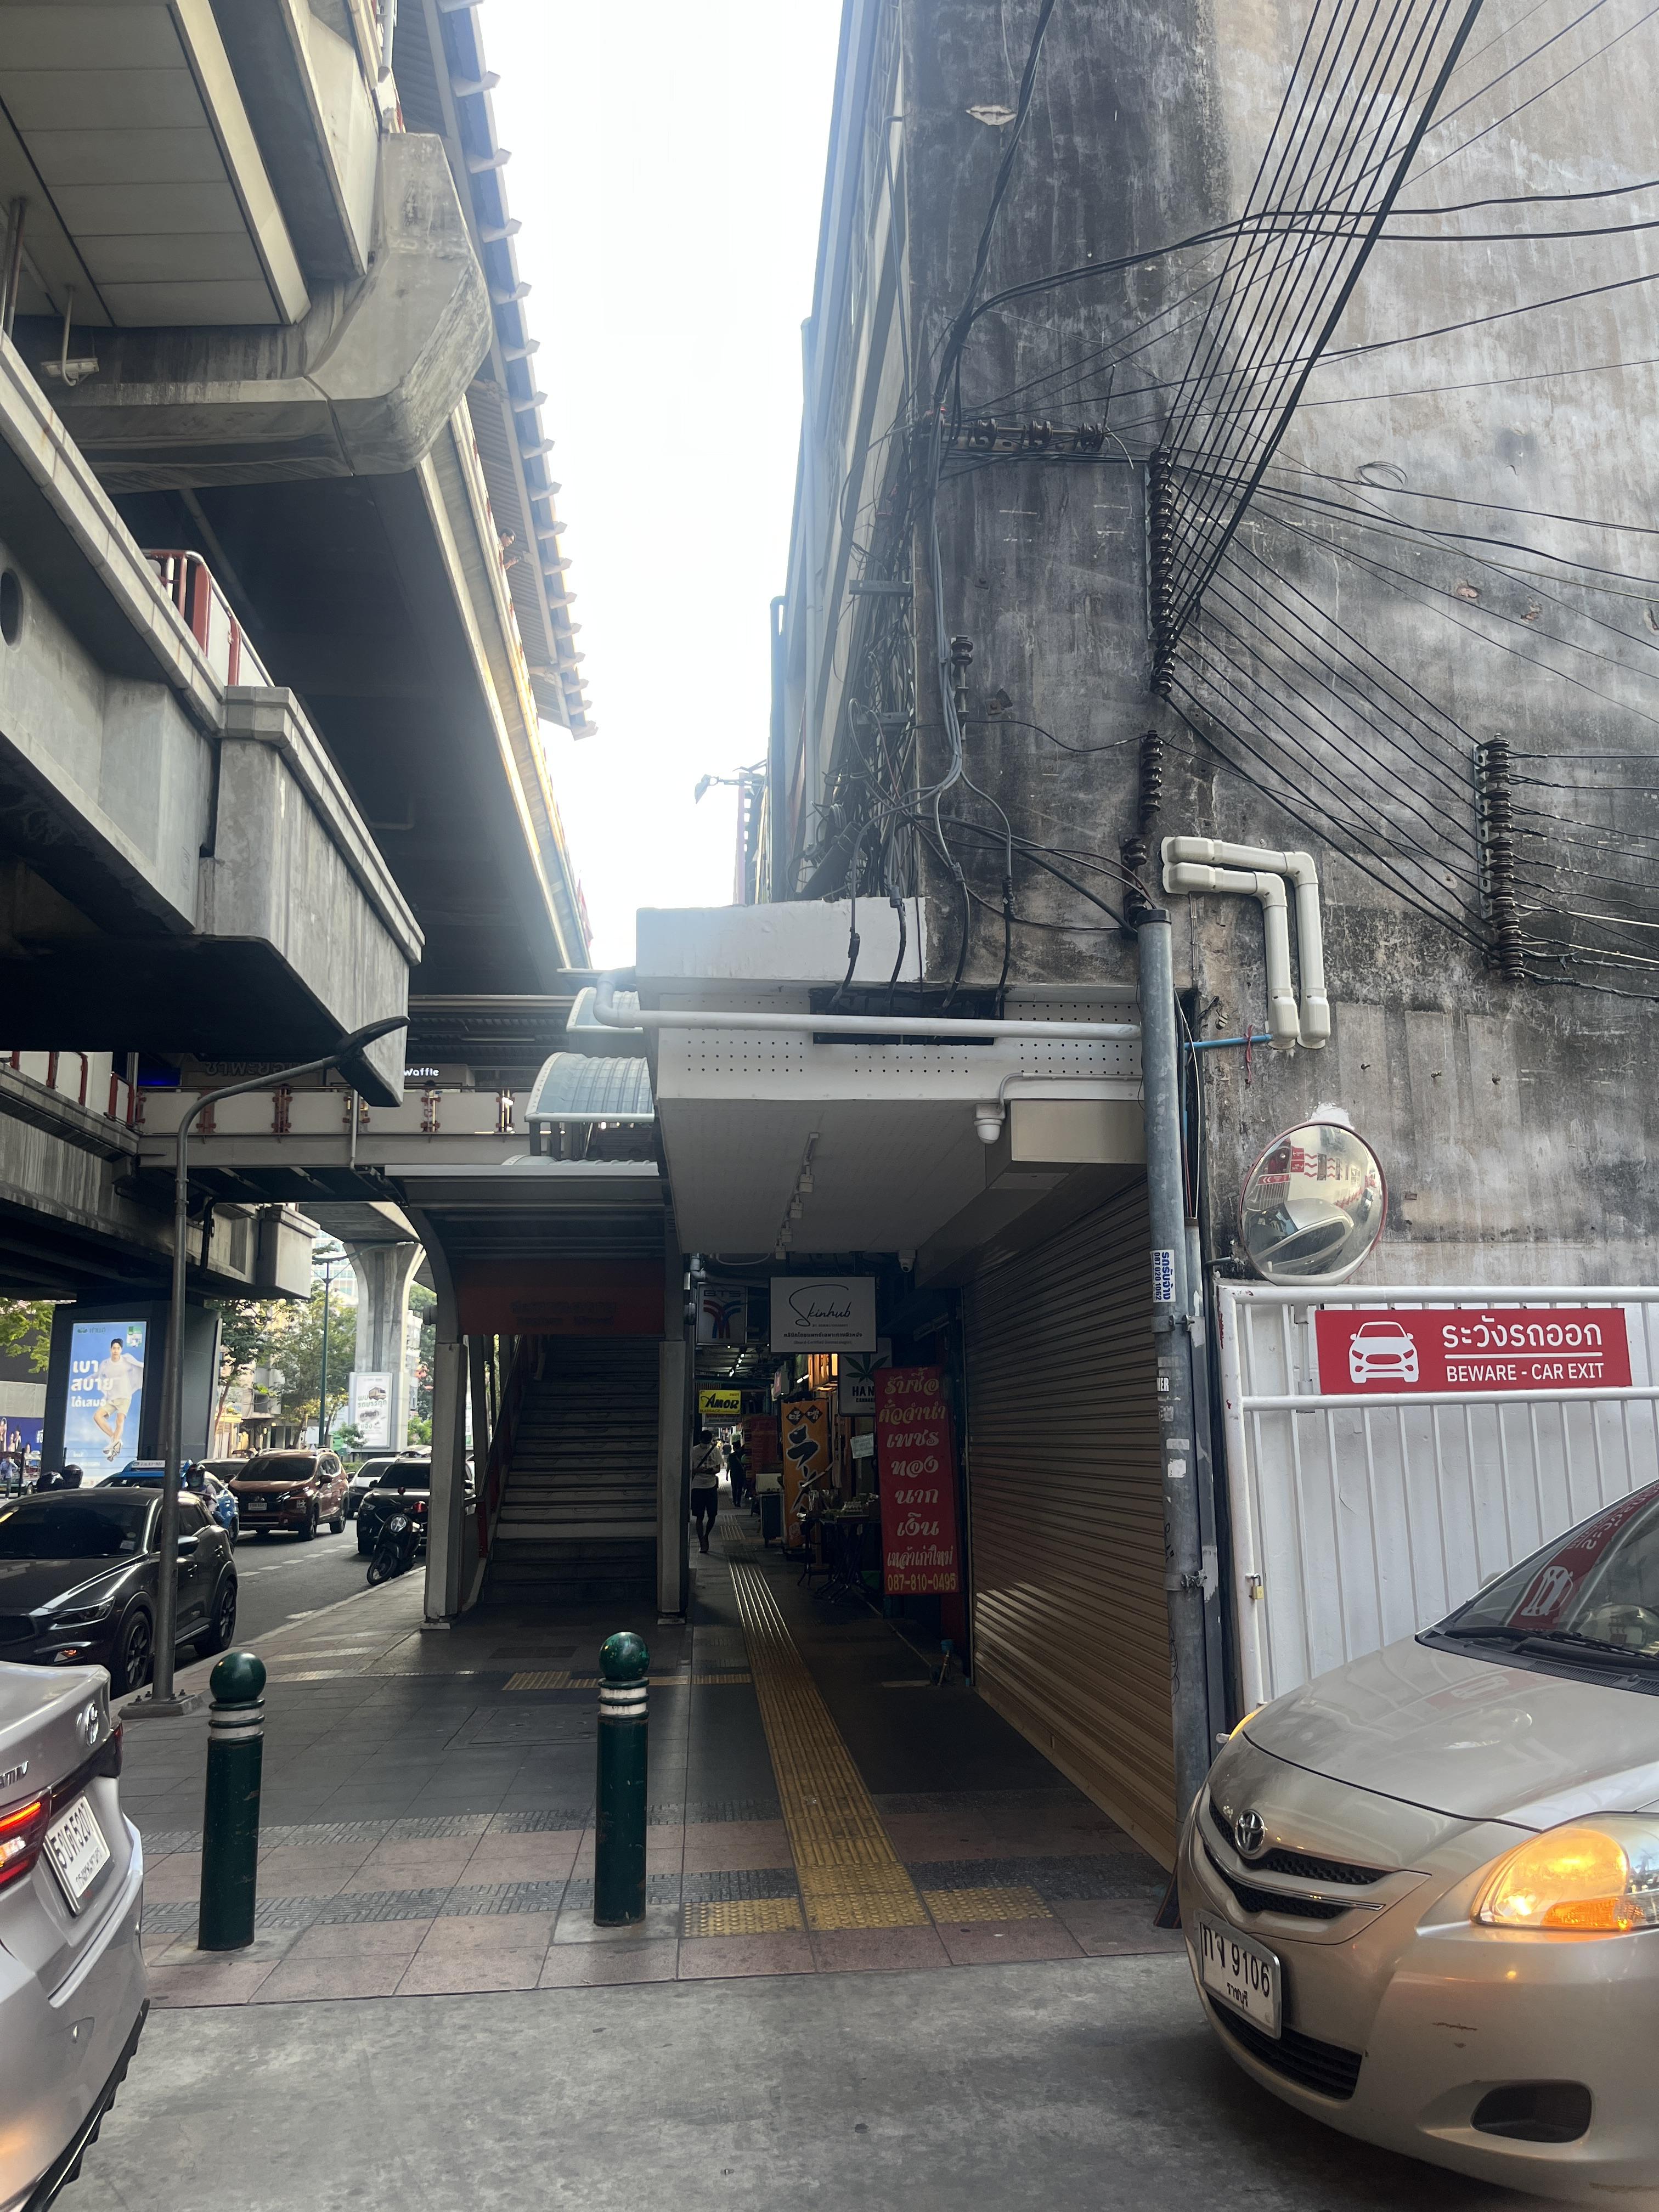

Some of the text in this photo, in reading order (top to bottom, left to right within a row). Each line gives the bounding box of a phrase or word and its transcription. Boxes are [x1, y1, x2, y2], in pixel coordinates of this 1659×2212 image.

[1162, 1251, 1173, 1300] รถรับจ้าง
[789, 1284, 852, 1327] Skinhub
[1442, 1314, 1602, 1347] ระวังรถออก
[72, 1359, 99, 1373] เบา
[1446, 1364, 1517, 1383] BEWARE
[1532, 1364, 1563, 1380] CAR
[1568, 1362, 1604, 1379] EXIT
[71, 1378, 114, 1391] สบาย
[852, 1386, 875, 1396] HAN
[884, 1367, 940, 1396] รับซื้อ
[887, 1429, 940, 1448] เพชร
[891, 1455, 939, 1478] ทอง
[895, 1488, 939, 1504] นาก
[896, 1511, 940, 1537] เงิน
[887, 1572, 956, 1591] 087-810-0495
[69, 1802, 94, 1847] 5207
[1231, 1942, 1271, 1999] 9106
[1226, 1982, 1249, 2011] ราชบุรี
